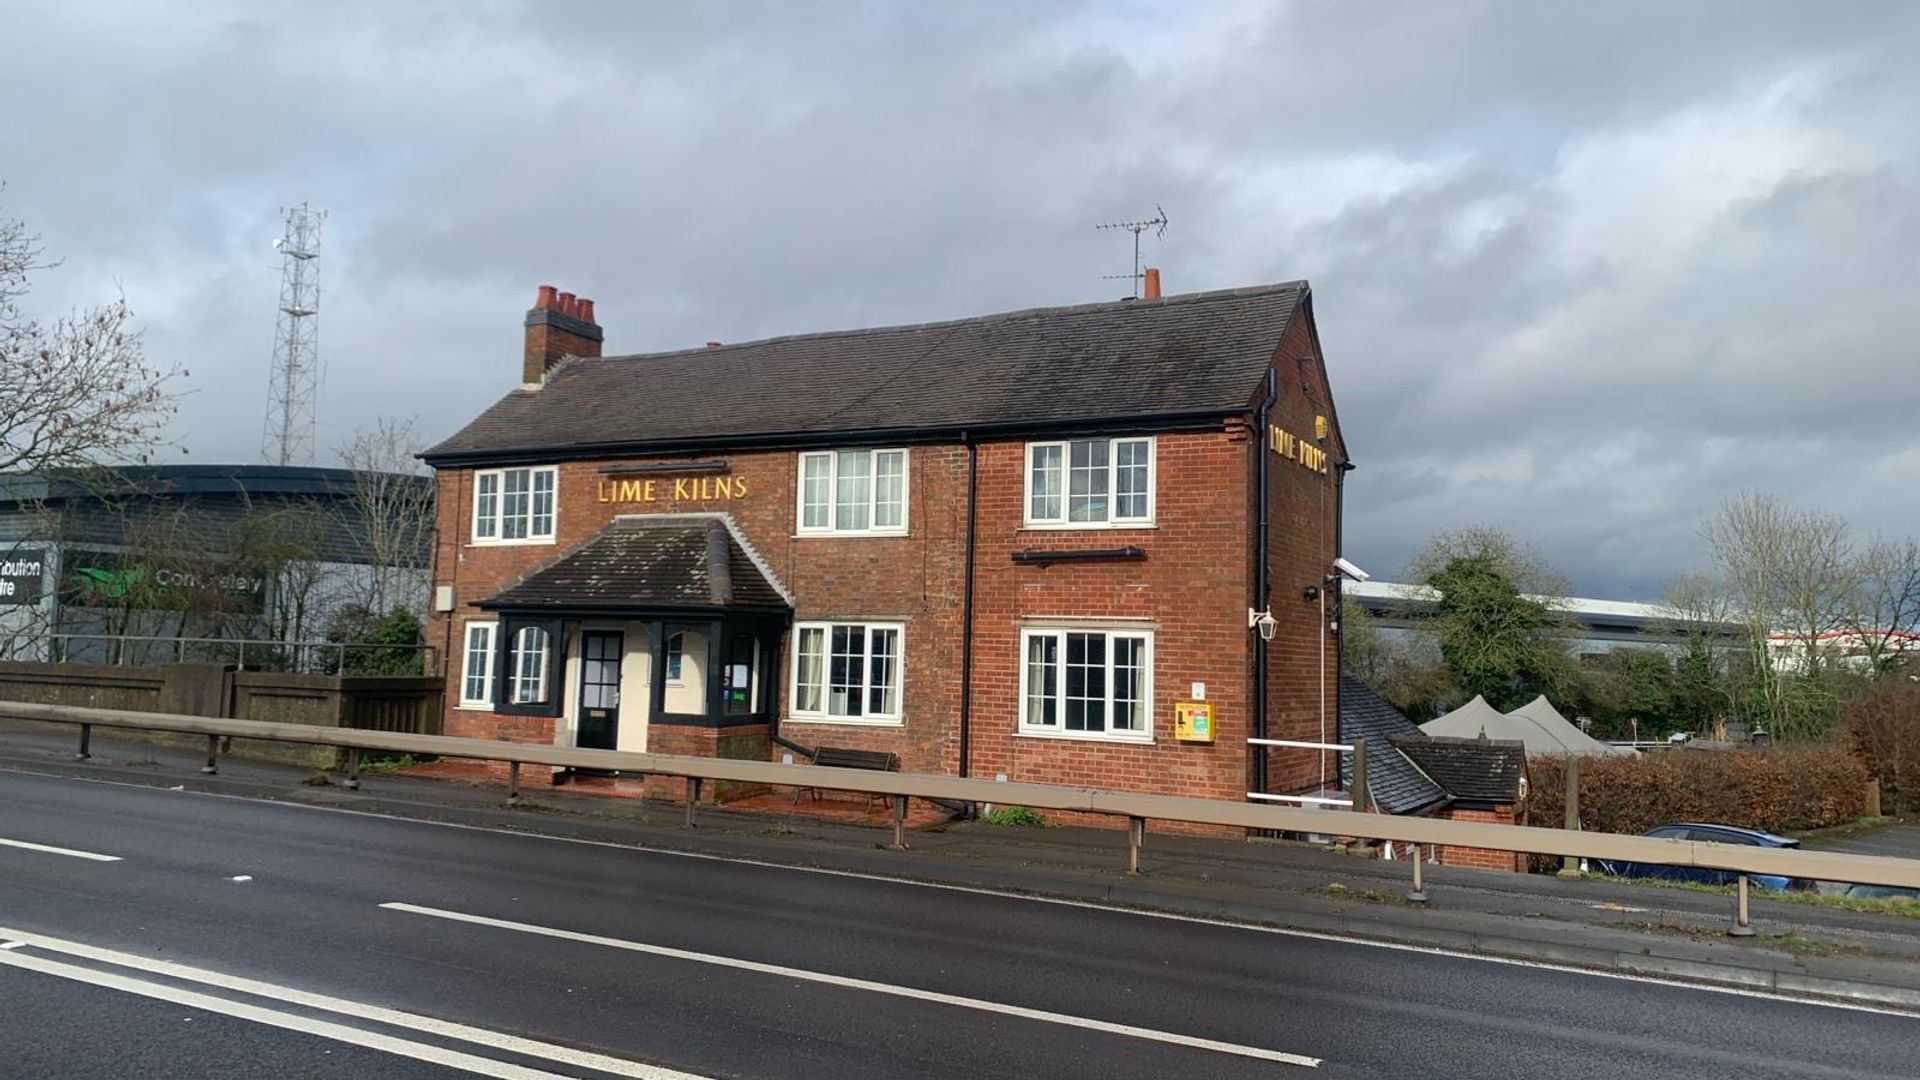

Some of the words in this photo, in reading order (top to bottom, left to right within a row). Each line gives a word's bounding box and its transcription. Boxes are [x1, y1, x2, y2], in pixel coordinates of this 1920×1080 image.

[598, 480, 656, 502] LIME
[674, 476, 748, 501] KILNS
[0, 577, 16, 596] tre
